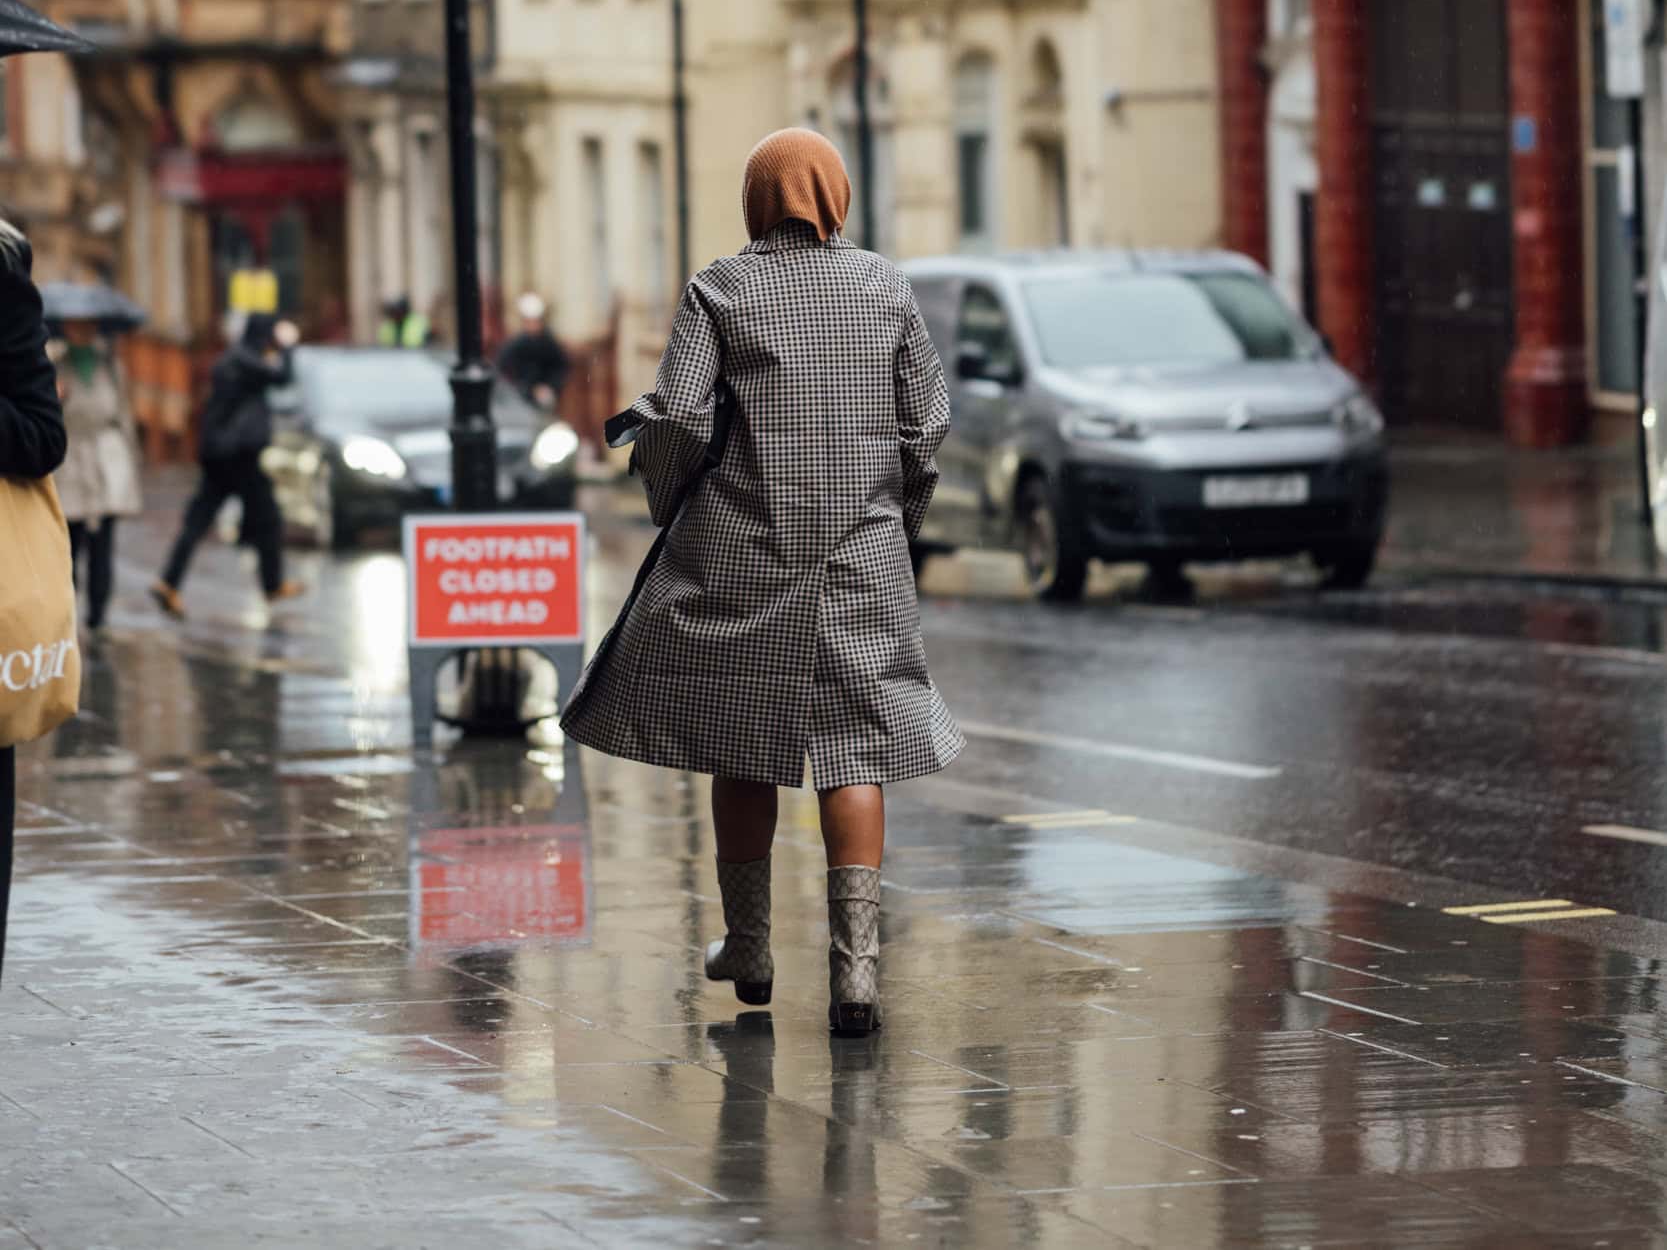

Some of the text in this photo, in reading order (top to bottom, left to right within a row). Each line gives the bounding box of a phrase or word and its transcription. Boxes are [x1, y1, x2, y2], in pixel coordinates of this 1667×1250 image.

[424, 536, 570, 562] FOOTPATH
[438, 568, 557, 594] CLOSED
[447, 600, 548, 625] AHEAD
